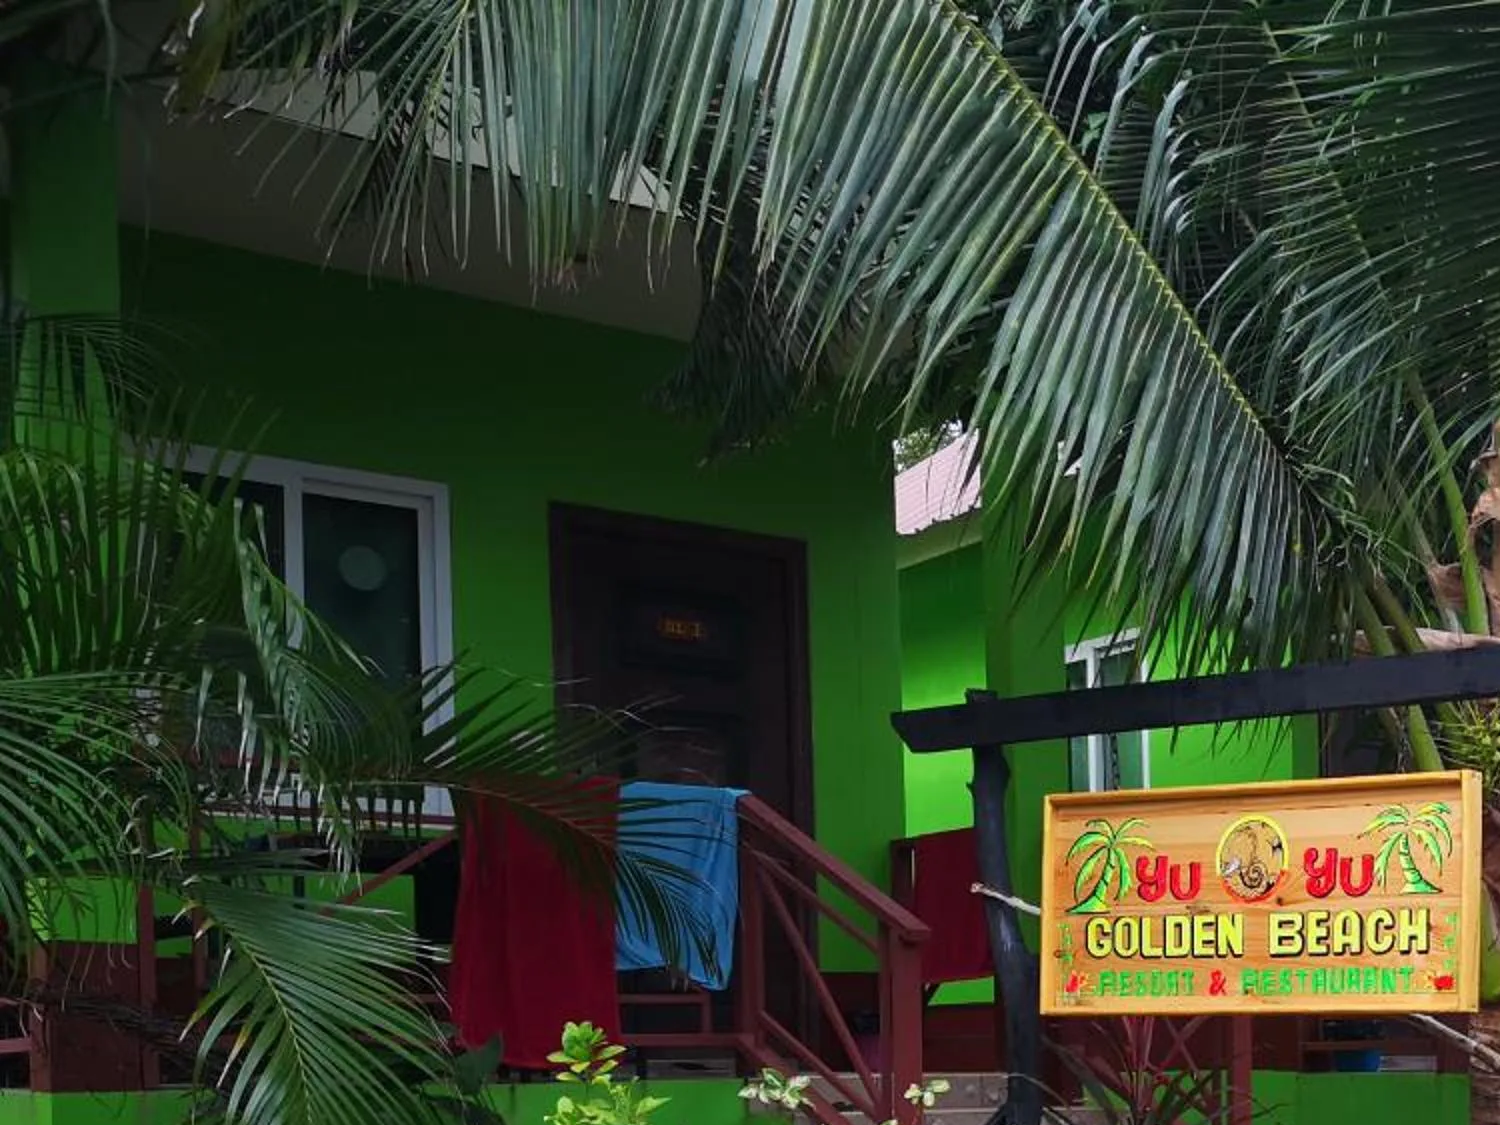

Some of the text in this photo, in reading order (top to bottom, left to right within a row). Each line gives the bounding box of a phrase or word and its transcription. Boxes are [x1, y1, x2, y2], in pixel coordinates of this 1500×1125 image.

[1086, 907, 1431, 959] GOLDEN BEACH
[1208, 970, 1227, 996] &
